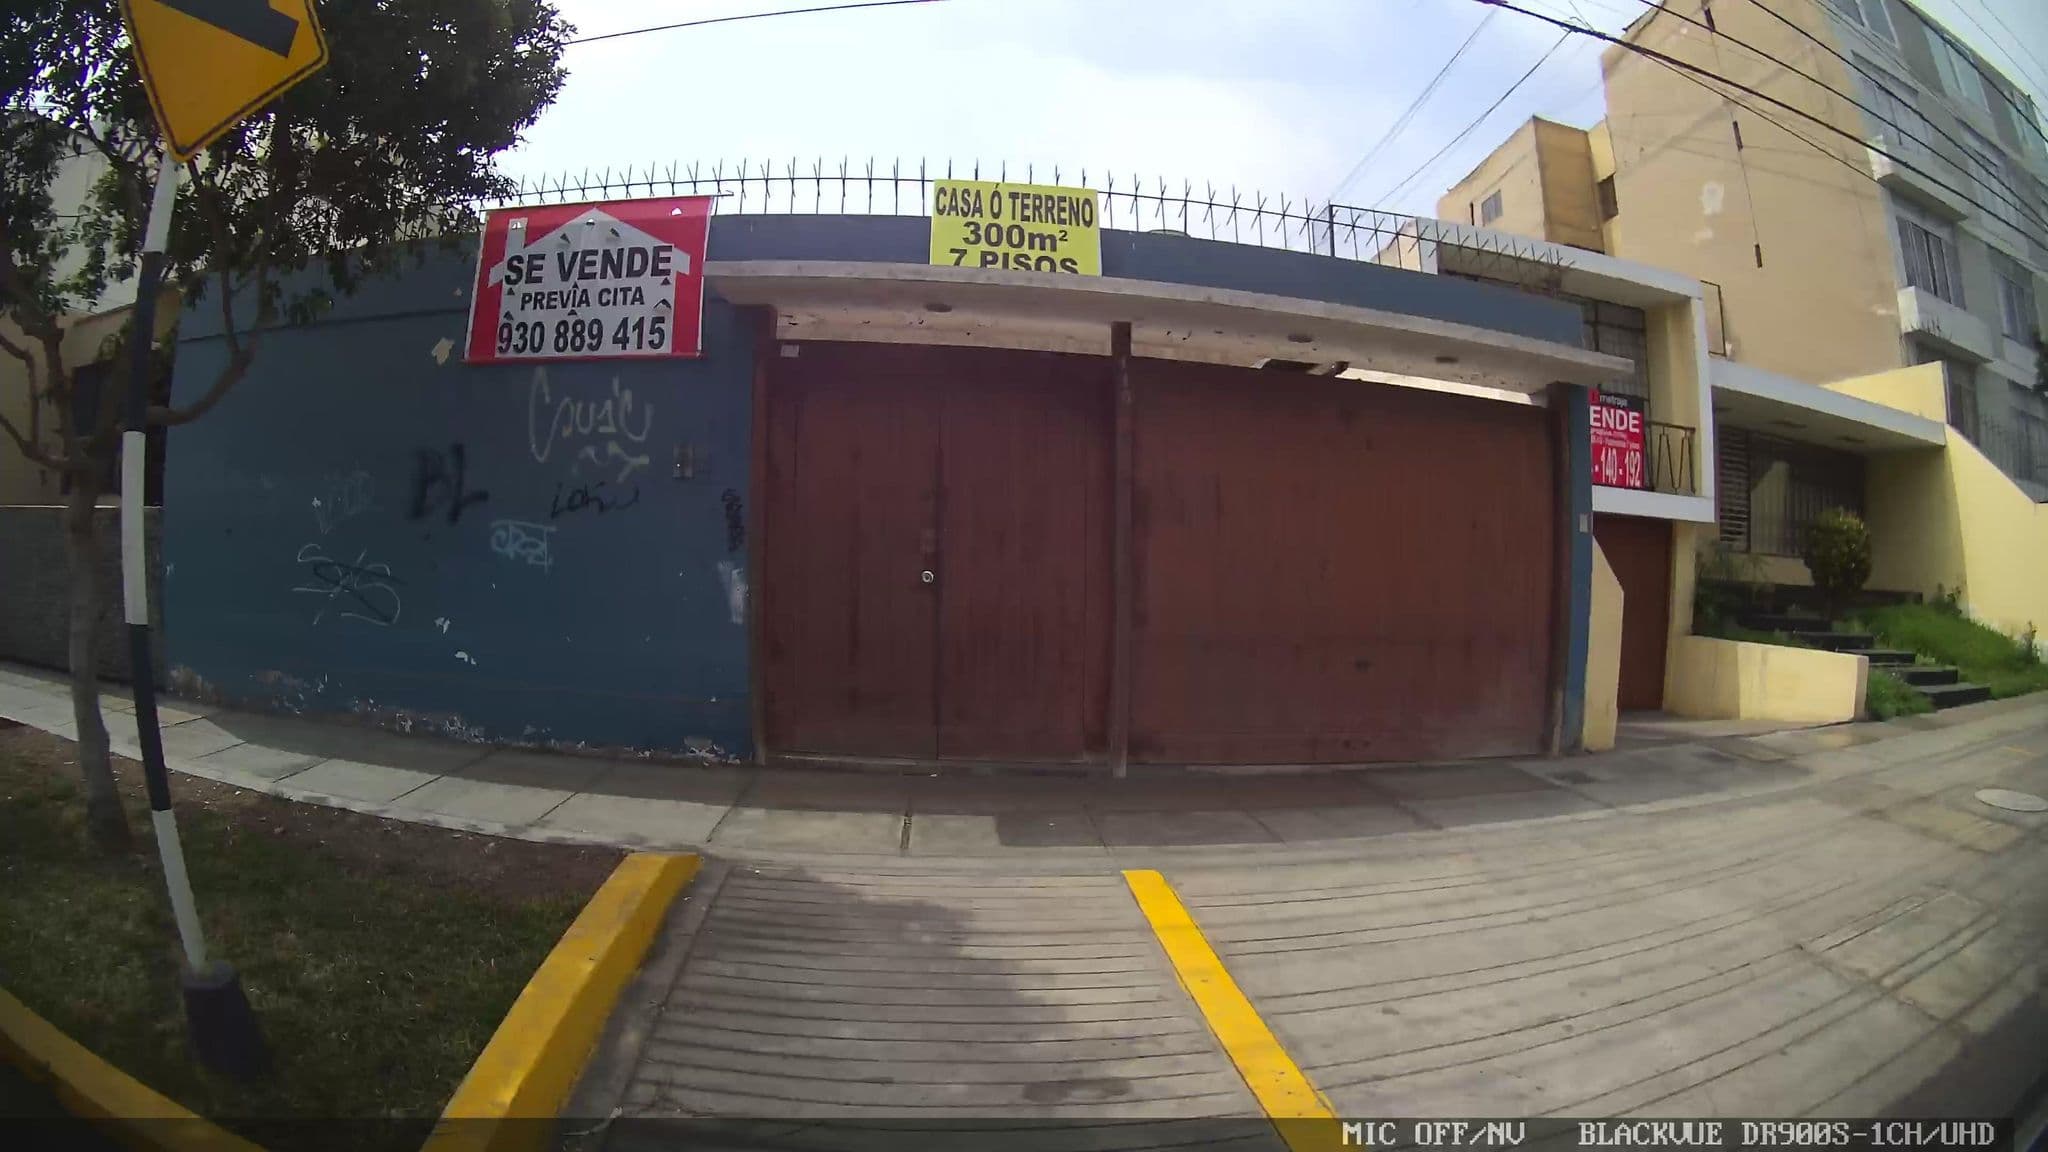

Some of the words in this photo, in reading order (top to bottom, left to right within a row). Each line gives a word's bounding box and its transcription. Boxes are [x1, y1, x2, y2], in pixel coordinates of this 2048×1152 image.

[935, 186, 983, 218] CASA
[1008, 191, 1093, 228] TERRENO
[504, 253, 546, 285] SE
[557, 245, 673, 282] VENDE
[950, 248, 967, 267] 7
[979, 250, 1079, 274] PISOS
[597, 286, 645, 307] CITA
[497, 320, 545, 354] 930
[553, 317, 603, 353] 889
[612, 316, 666, 350] 415
[1589, 405, 1640, 433] ENDE
[1601, 446, 1617, 485] 140
[1624, 450, 1641, 488] 192
